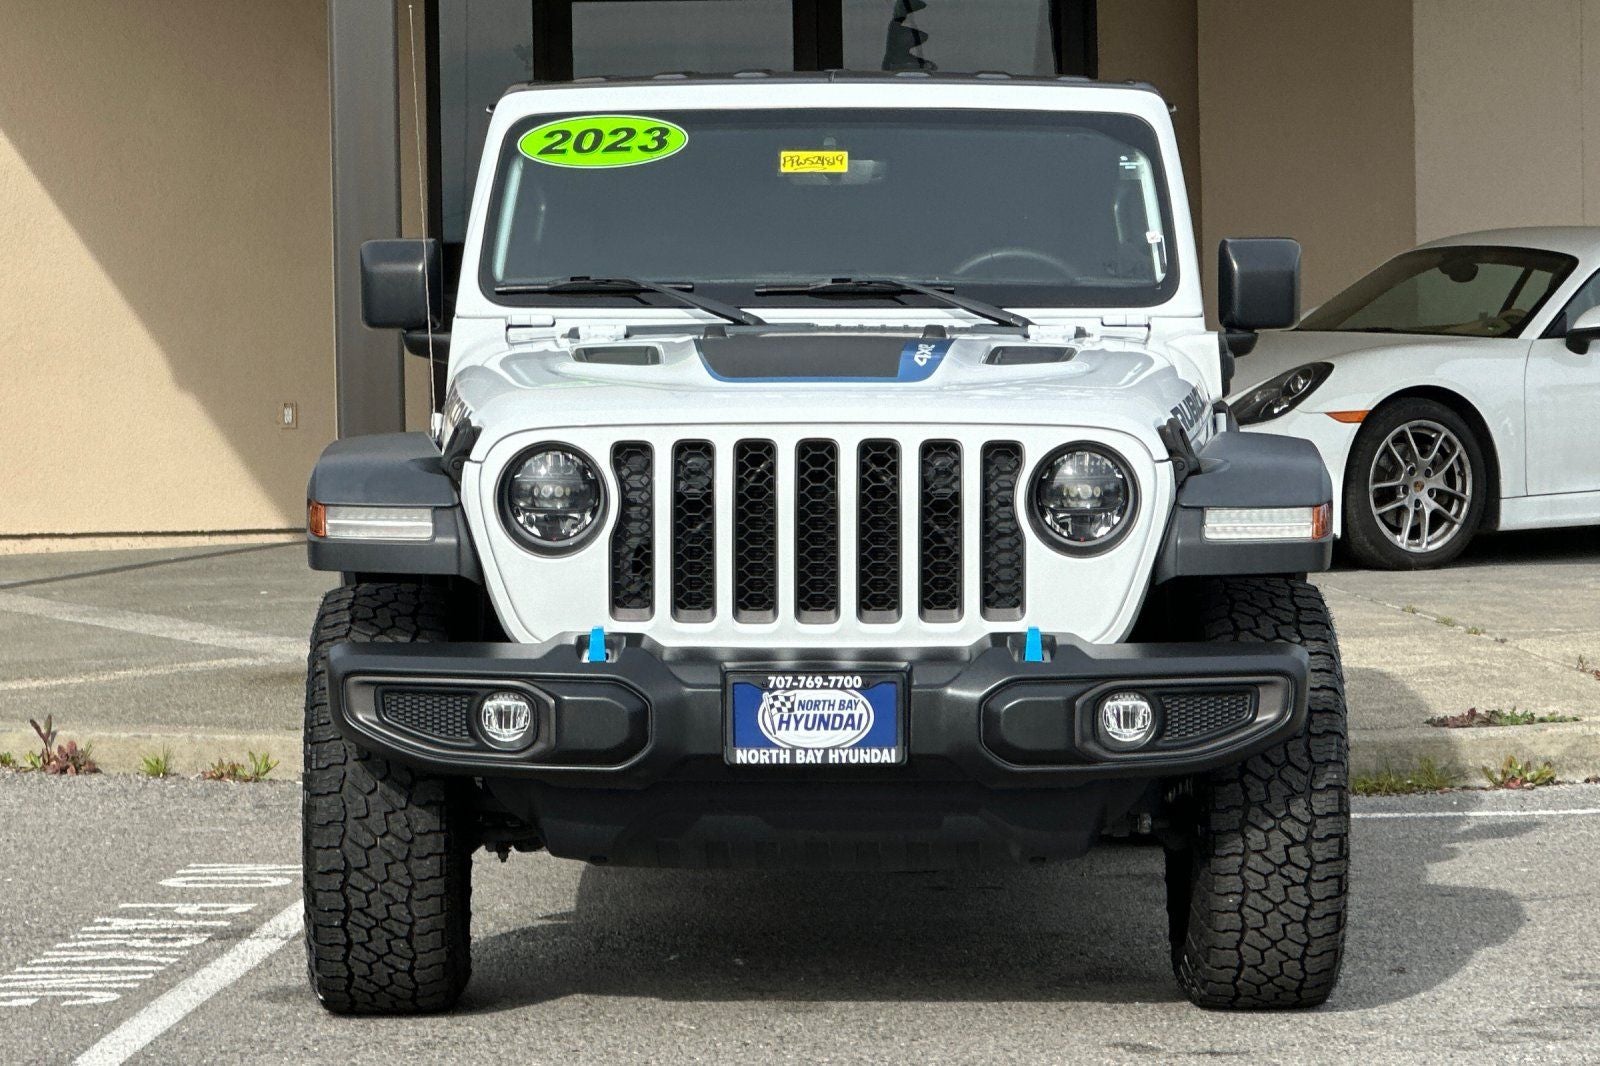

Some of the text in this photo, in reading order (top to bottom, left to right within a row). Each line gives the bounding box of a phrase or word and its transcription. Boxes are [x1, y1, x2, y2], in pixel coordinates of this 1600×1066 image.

[537, 127, 671, 156] 2023
[768, 676, 862, 688] 707-769-7700
[797, 700, 861, 711] NORTH BAY
[777, 714, 864, 731] HYUNDAI
[736, 749, 896, 763] NORTH BAY HYUNDAI
